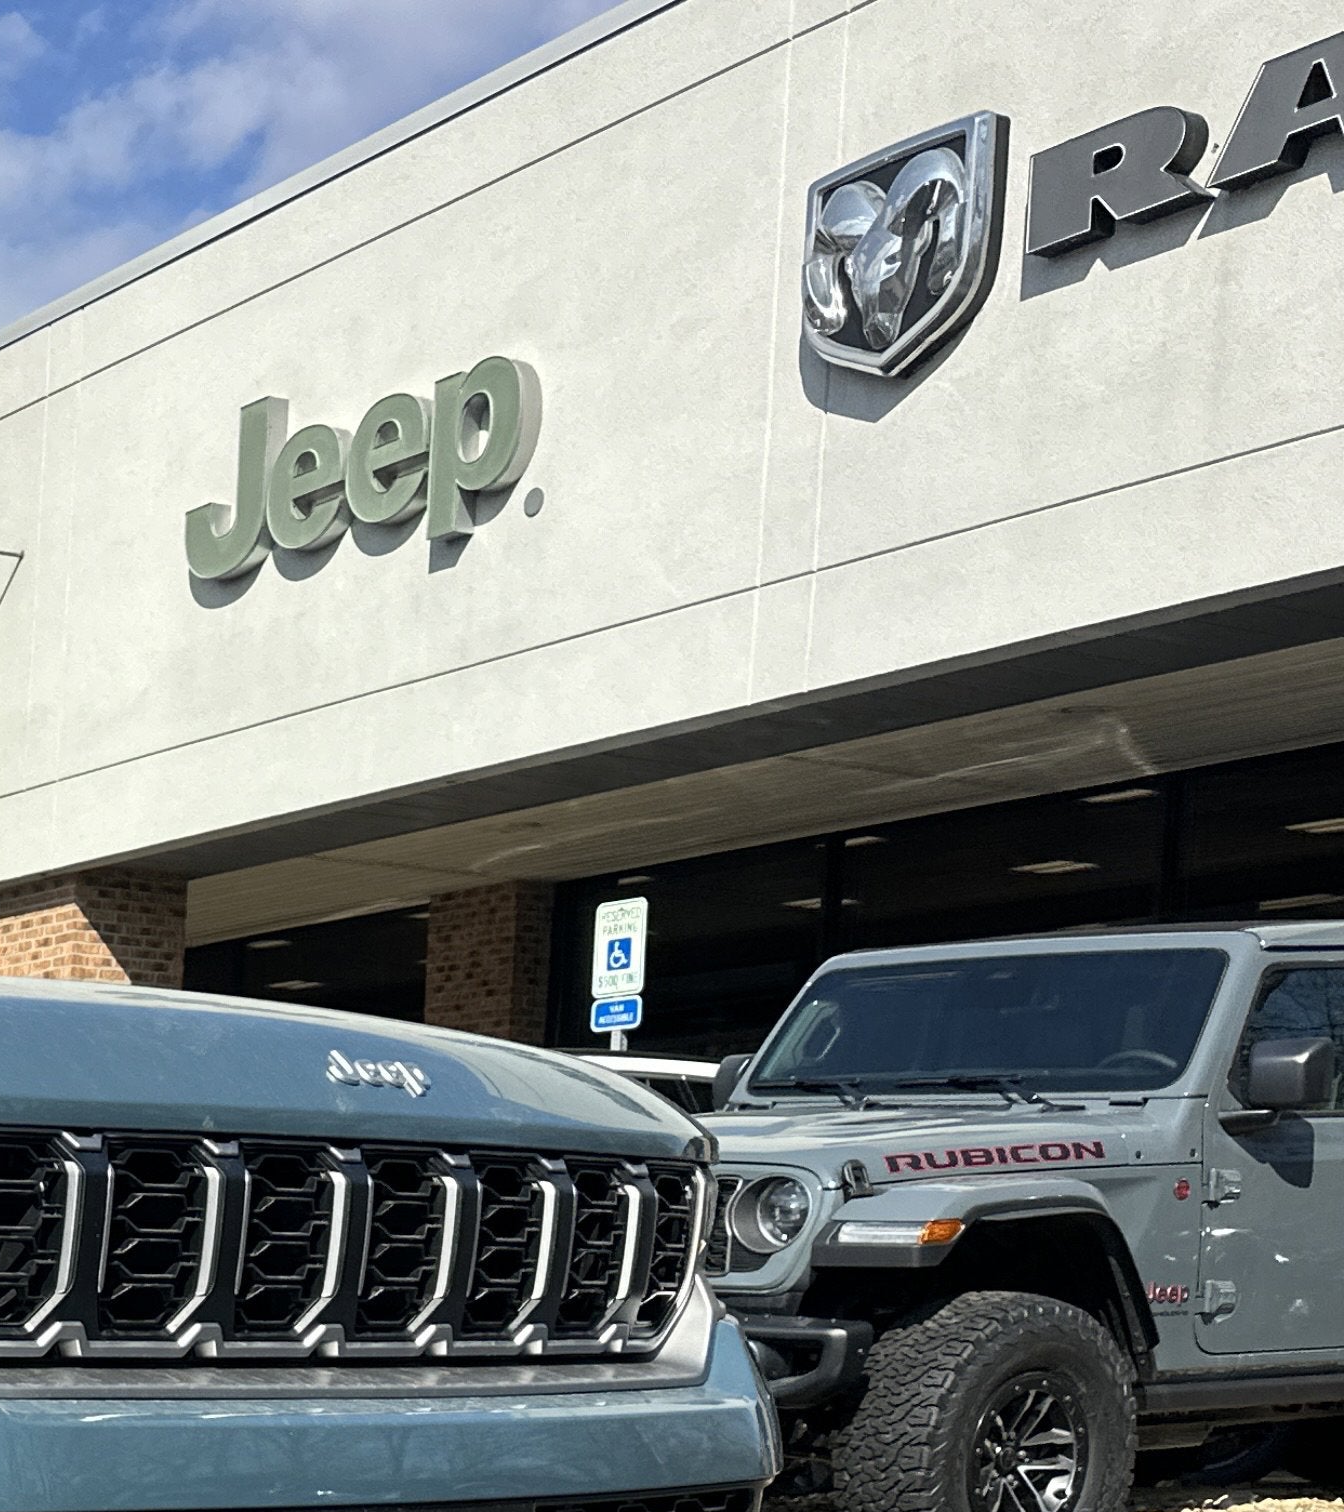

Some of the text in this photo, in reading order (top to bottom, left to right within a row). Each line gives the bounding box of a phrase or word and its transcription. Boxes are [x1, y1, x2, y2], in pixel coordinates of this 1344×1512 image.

[185, 356, 542, 580] Jeep
[326, 1050, 431, 1098] Jeep
[884, 1140, 1106, 1173] RUBICON
[1146, 1281, 1190, 1305] Jeep
